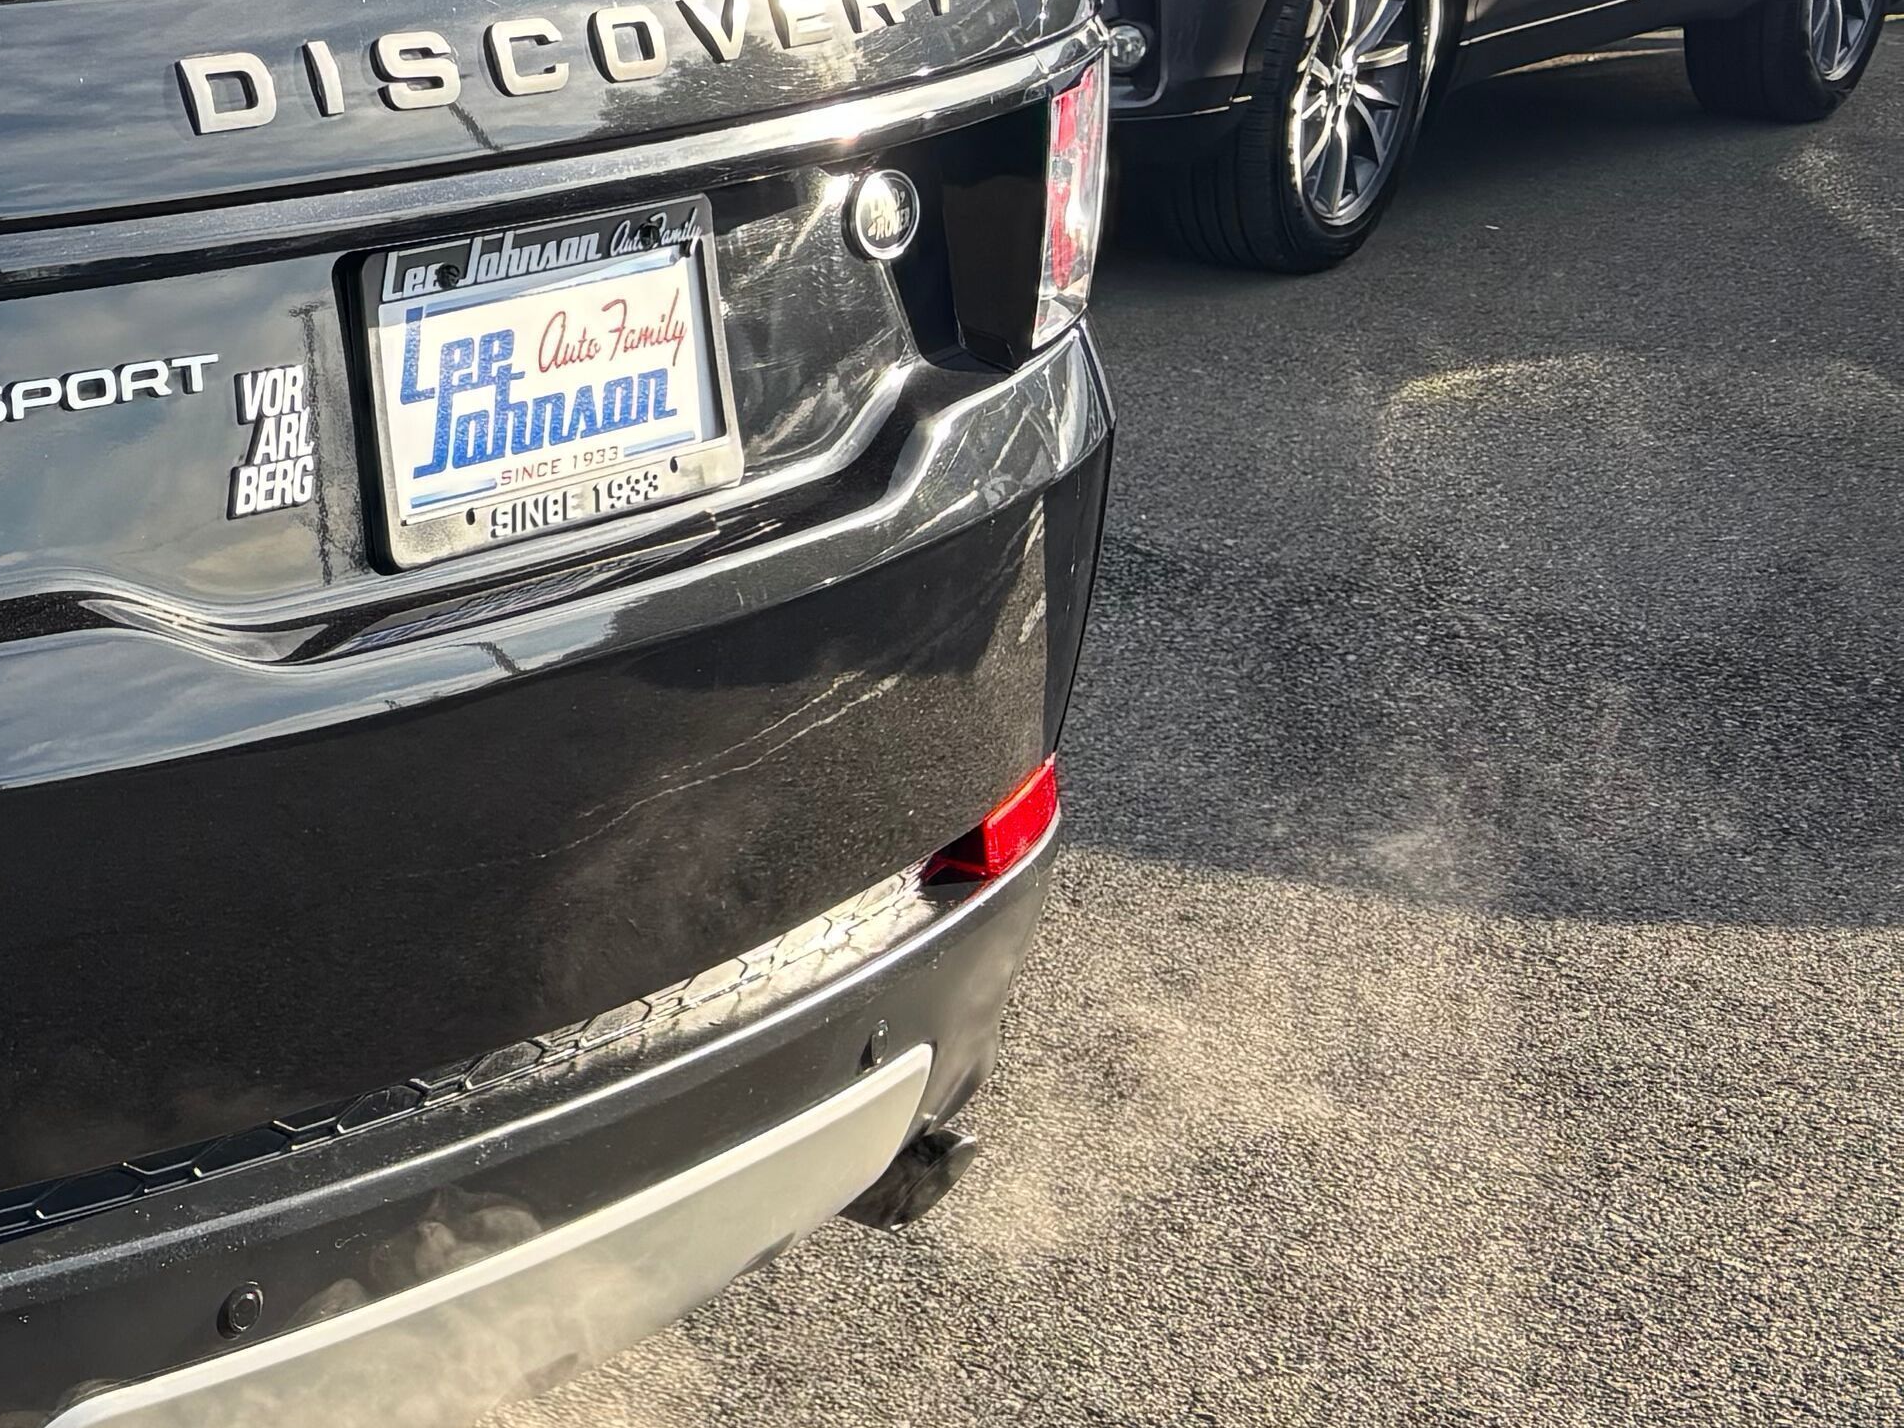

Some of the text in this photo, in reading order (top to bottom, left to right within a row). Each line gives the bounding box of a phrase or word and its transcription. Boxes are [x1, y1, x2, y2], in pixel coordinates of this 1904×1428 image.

[456, 230, 603, 288] Johnson
[610, 219, 648, 257] Aut
[400, 287, 687, 405] Lee Auto Family
[241, 363, 306, 421] VOR
[413, 366, 678, 480] Johnson
[253, 406, 316, 466] ARL
[500, 445, 619, 487] SINCE 1933
[234, 454, 315, 516] BERG
[490, 470, 661, 540] SINCE 1933
